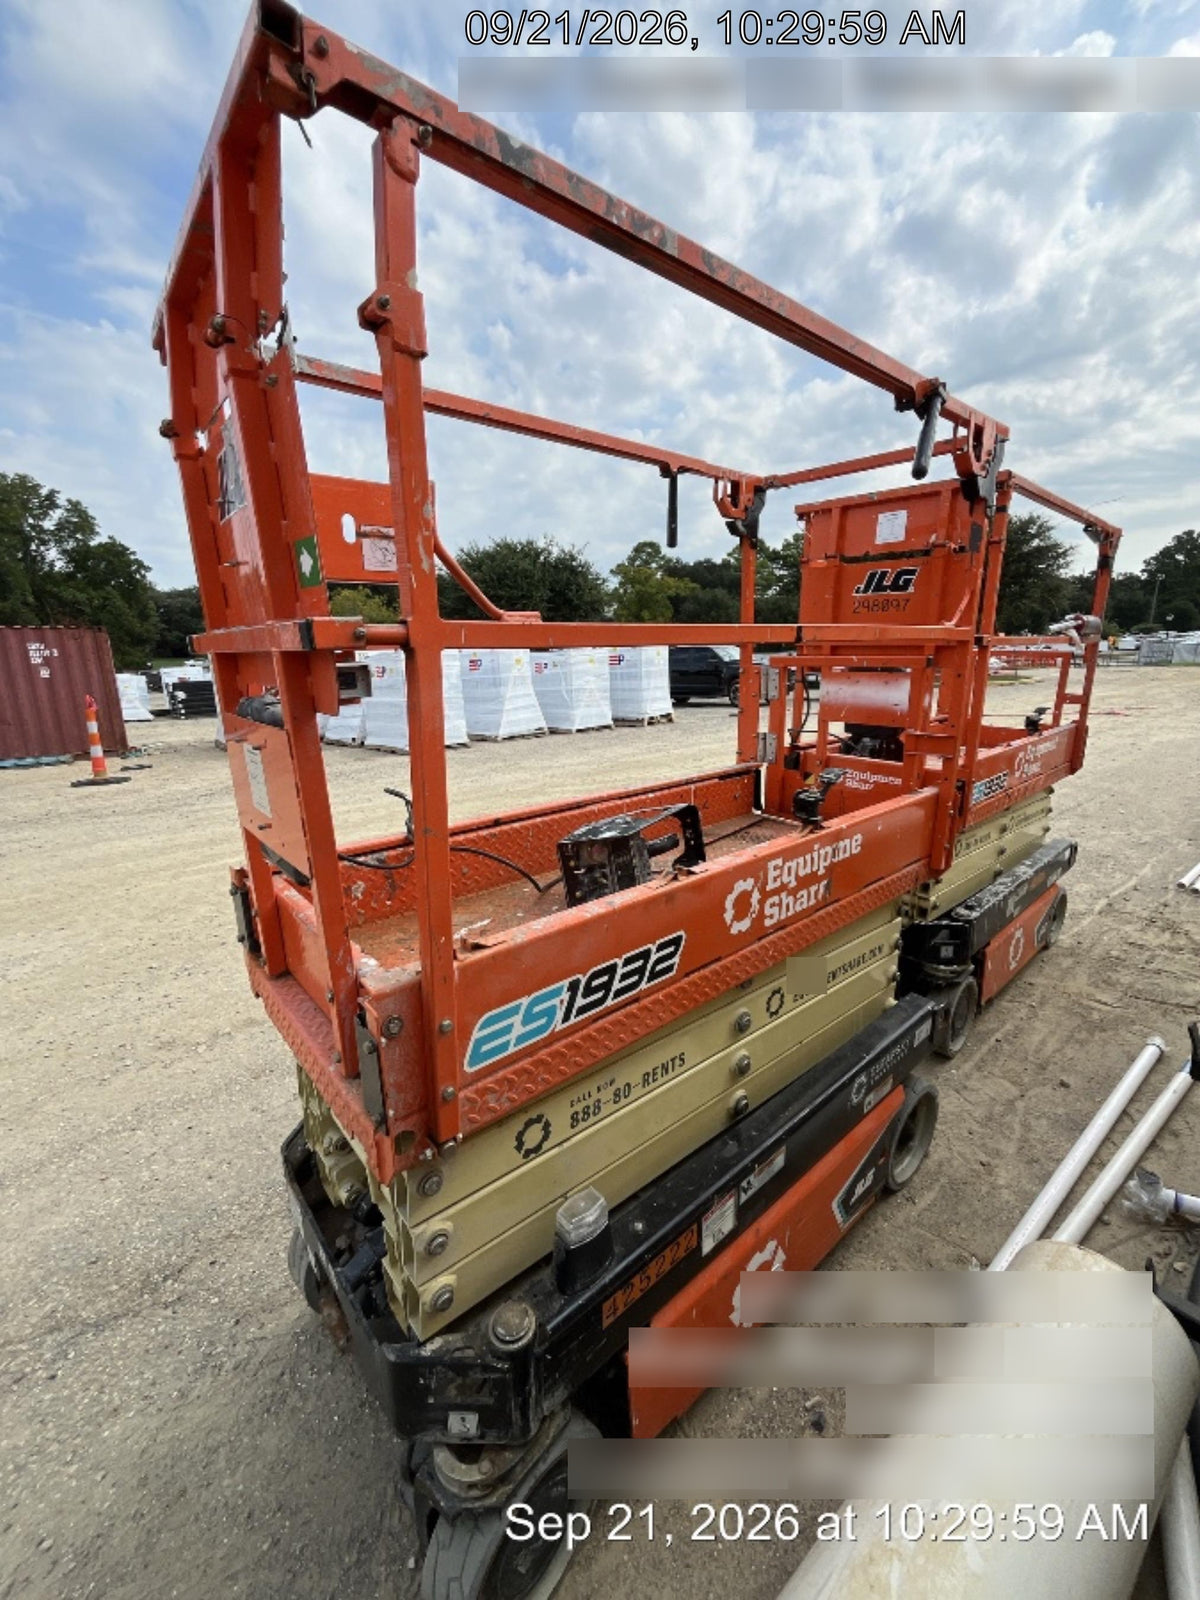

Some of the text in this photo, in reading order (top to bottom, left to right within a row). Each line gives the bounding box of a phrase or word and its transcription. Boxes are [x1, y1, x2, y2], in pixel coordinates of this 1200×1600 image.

[852, 567, 919, 596] JLG
[463, 930, 687, 1073] ES1932
[605, 1225, 697, 1319] 425222
